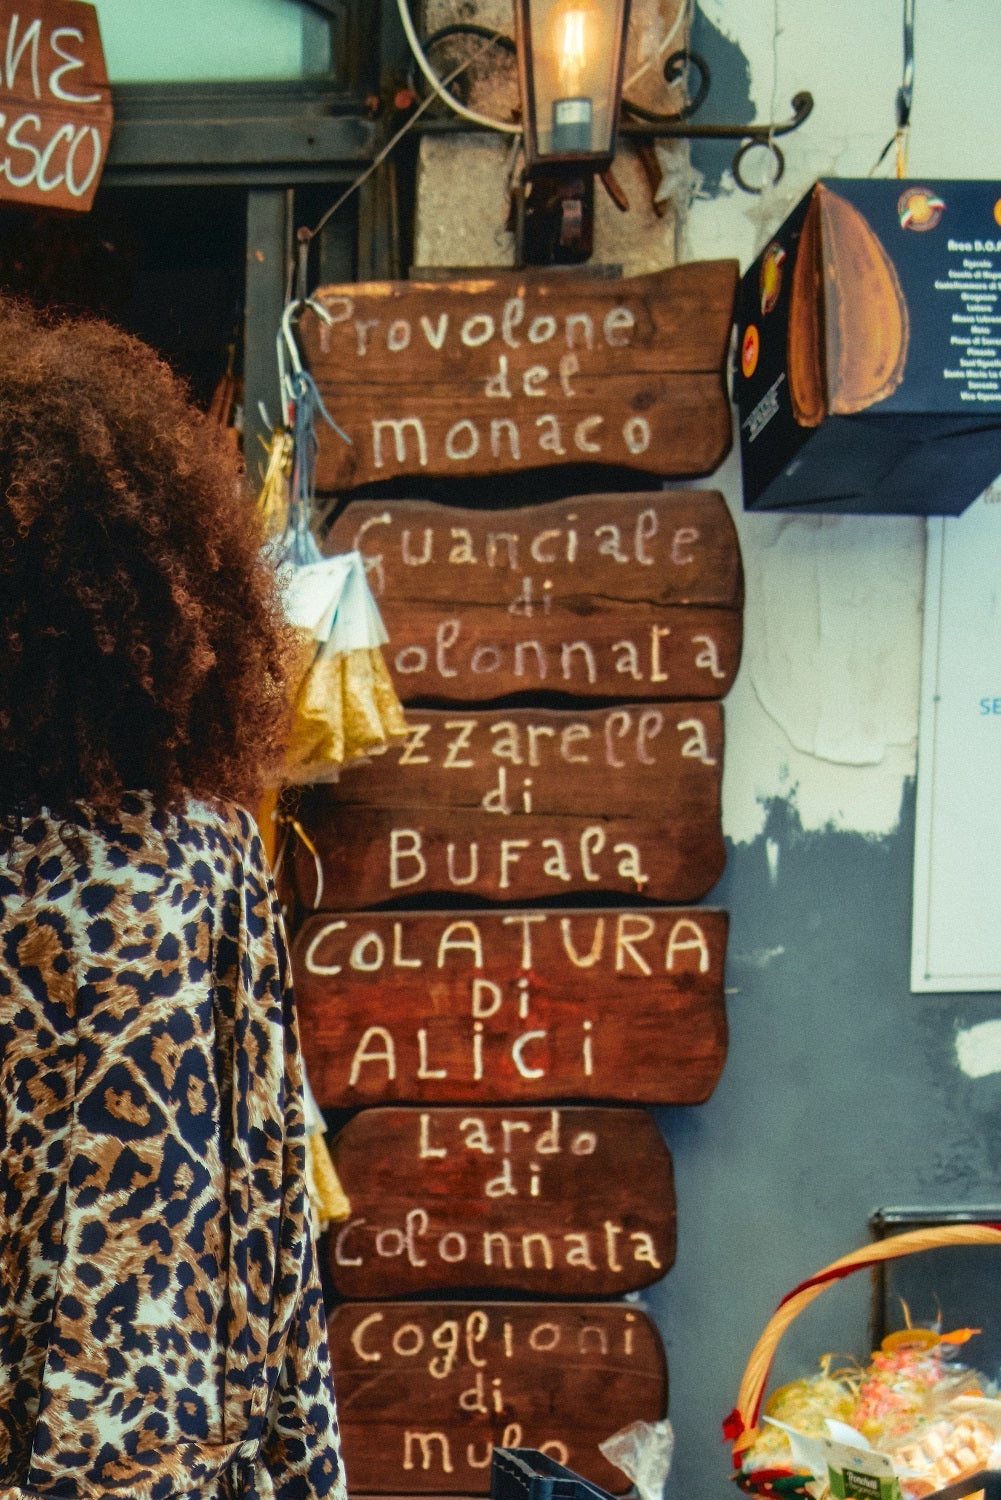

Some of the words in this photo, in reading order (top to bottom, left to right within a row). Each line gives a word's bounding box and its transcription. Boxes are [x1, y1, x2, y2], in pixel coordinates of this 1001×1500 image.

[318, 296, 635, 356] Provolone
[485, 352, 580, 399] del
[507, 577, 554, 618] di
[395, 618, 725, 683] olonnata
[397, 711, 717, 768] zzarella
[480, 768, 533, 815] di
[419, 1110, 597, 1160] Lardo
[485, 1160, 542, 1200] di
[334, 1208, 662, 1272] Colonnata
[353, 1311, 634, 1378] Coglioni
[458, 1378, 503, 1415] di
